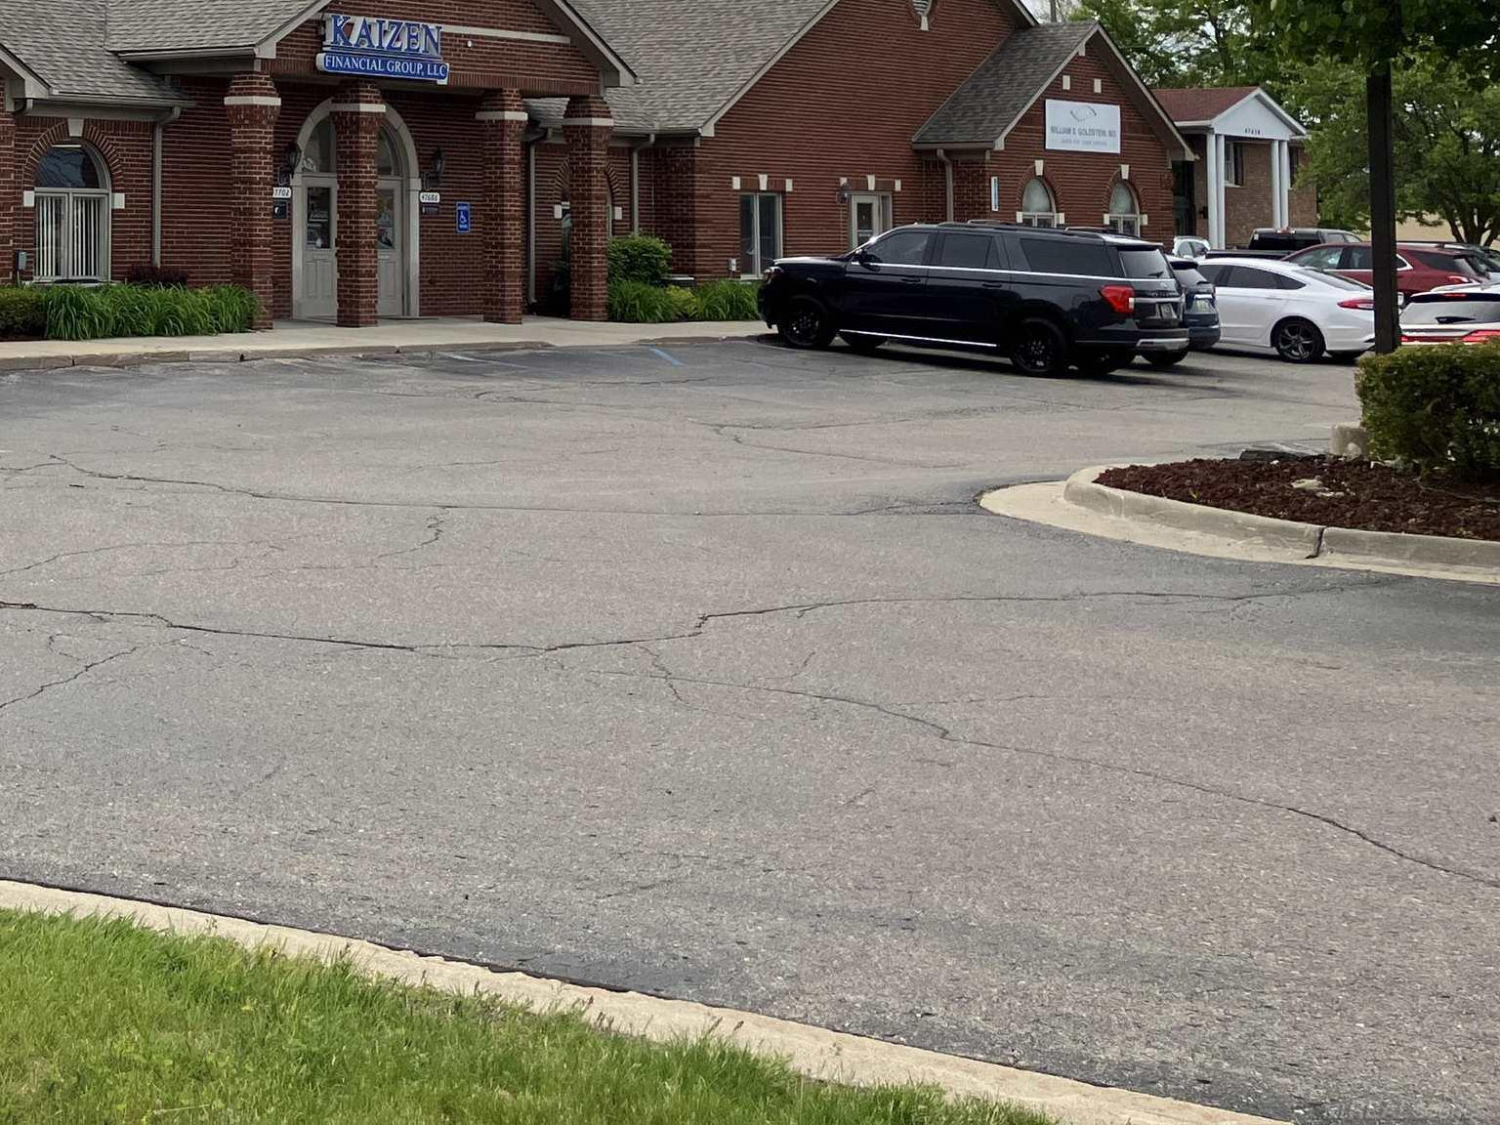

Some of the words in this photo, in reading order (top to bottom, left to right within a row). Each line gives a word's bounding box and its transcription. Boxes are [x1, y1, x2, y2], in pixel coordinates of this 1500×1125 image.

[331, 15, 442, 55] KAIZEN
[325, 56, 385, 72] FINANCIAL
[386, 60, 425, 76] GROUP,
[427, 63, 447, 77] LLC
[274, 188, 290, 196] 7702
